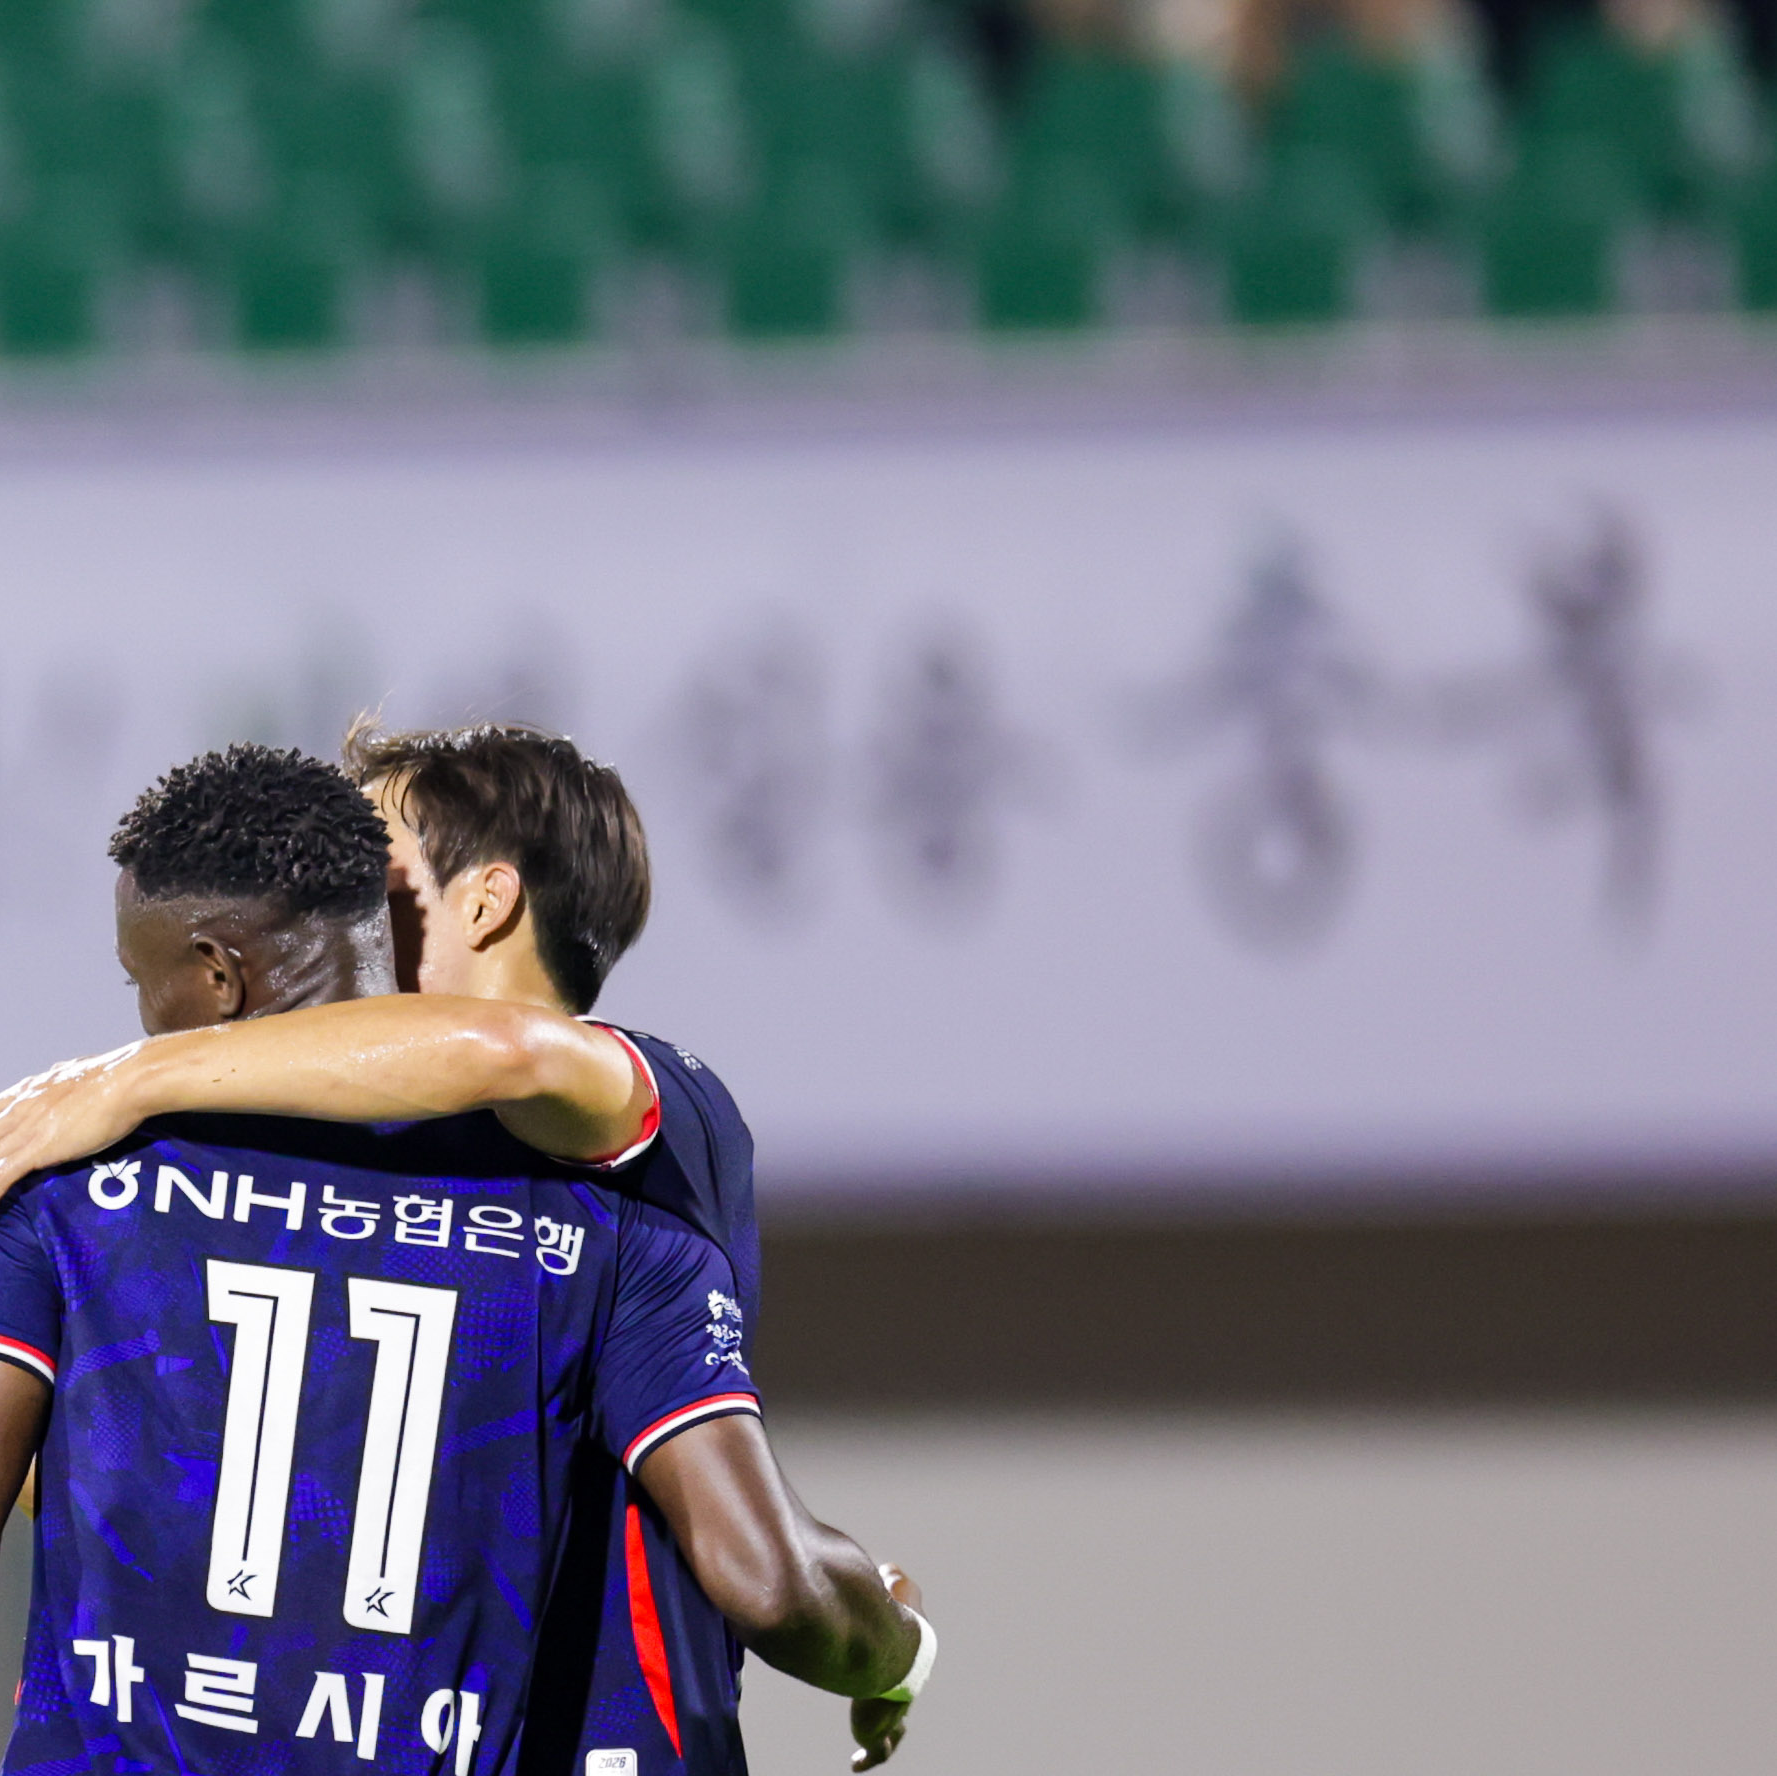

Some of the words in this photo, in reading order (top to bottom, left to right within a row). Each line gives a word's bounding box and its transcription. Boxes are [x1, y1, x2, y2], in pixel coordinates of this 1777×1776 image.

[154, 1164, 585, 1276] NH농협은행
[205, 1259, 457, 1634] 11
[599, 1756, 627, 1769] 2026
